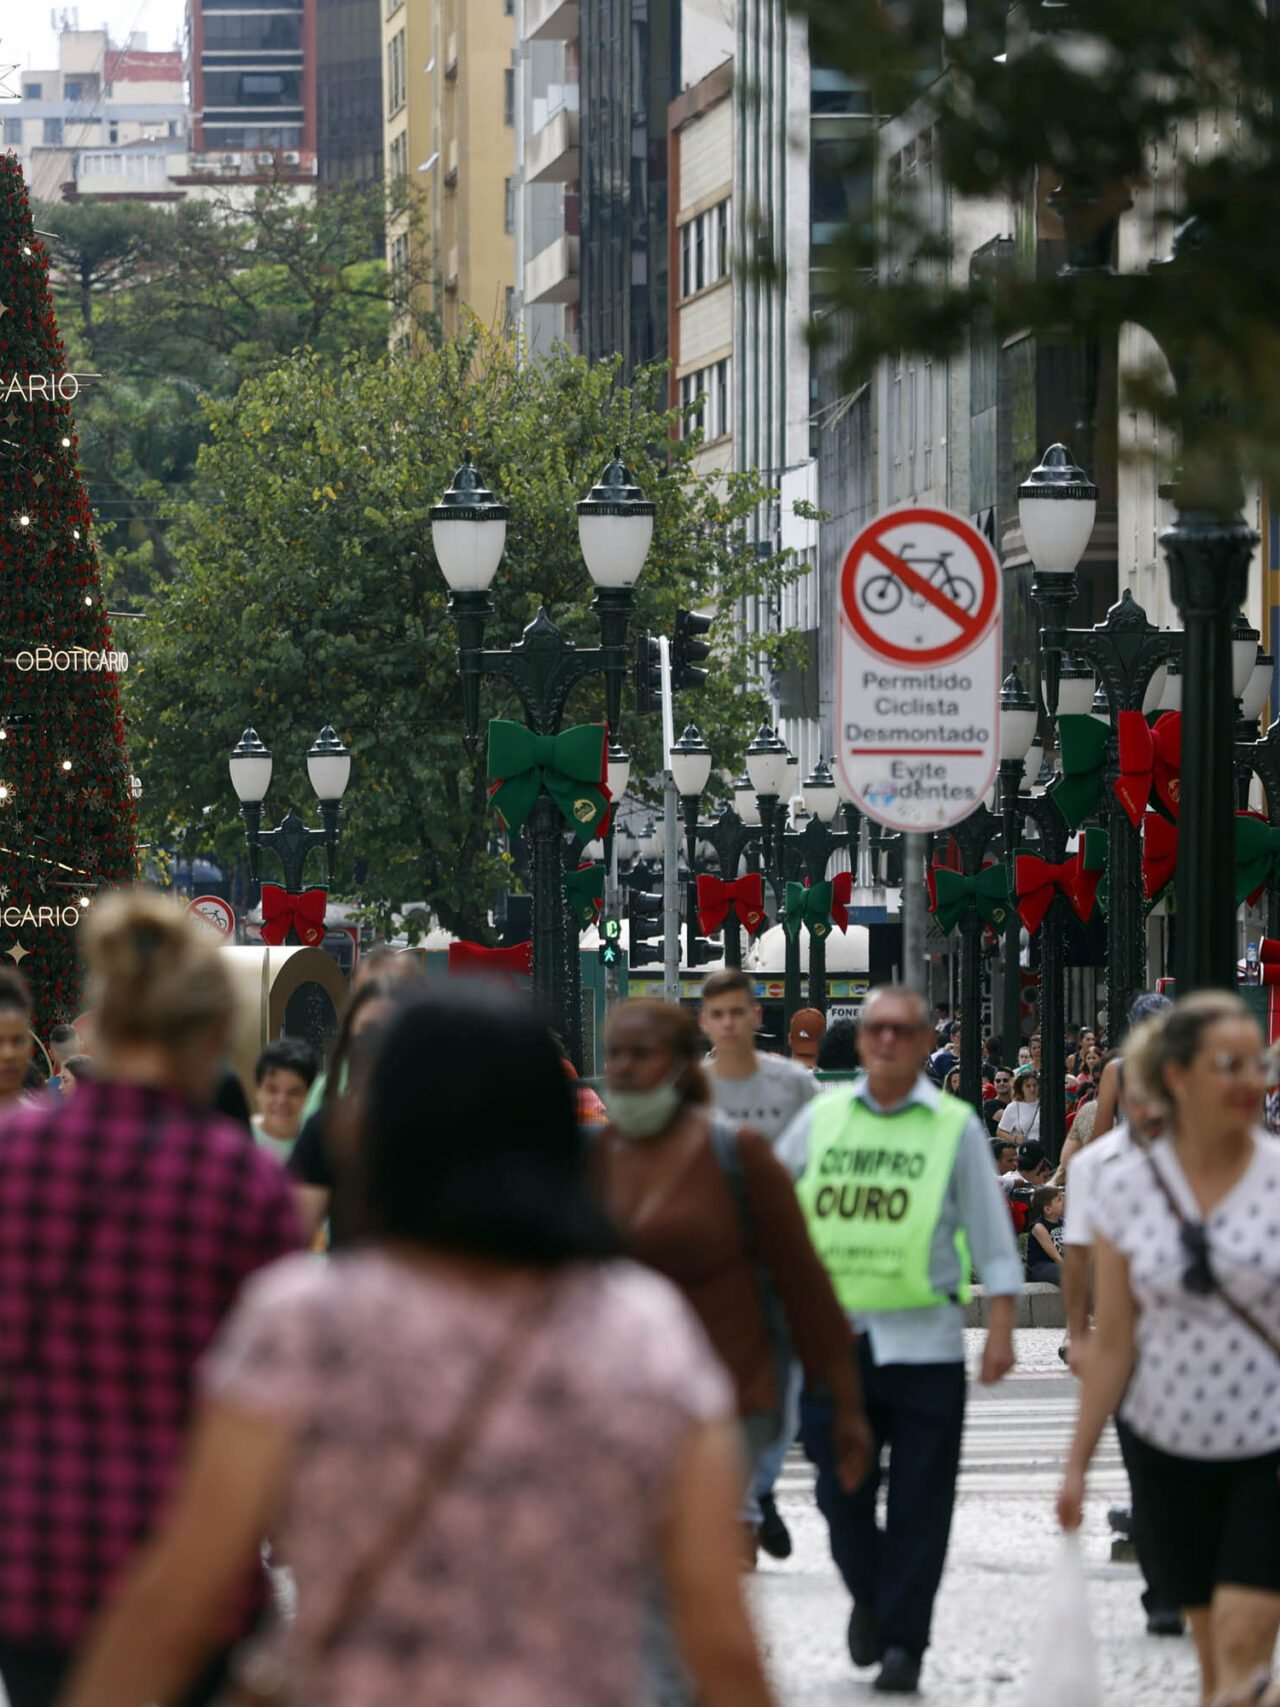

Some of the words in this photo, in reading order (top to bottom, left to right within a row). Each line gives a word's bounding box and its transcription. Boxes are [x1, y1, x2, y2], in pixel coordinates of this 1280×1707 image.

[862, 671, 972, 691] Permitido
[874, 698, 960, 716] Ciclista
[845, 723, 990, 744] Desmontado
[891, 760, 948, 781] Evite
[862, 781, 976, 801] identes
[831, 1008, 860, 1017] FONE
[820, 1149, 926, 1180] COMPRO
[816, 1185, 909, 1221] OURO
